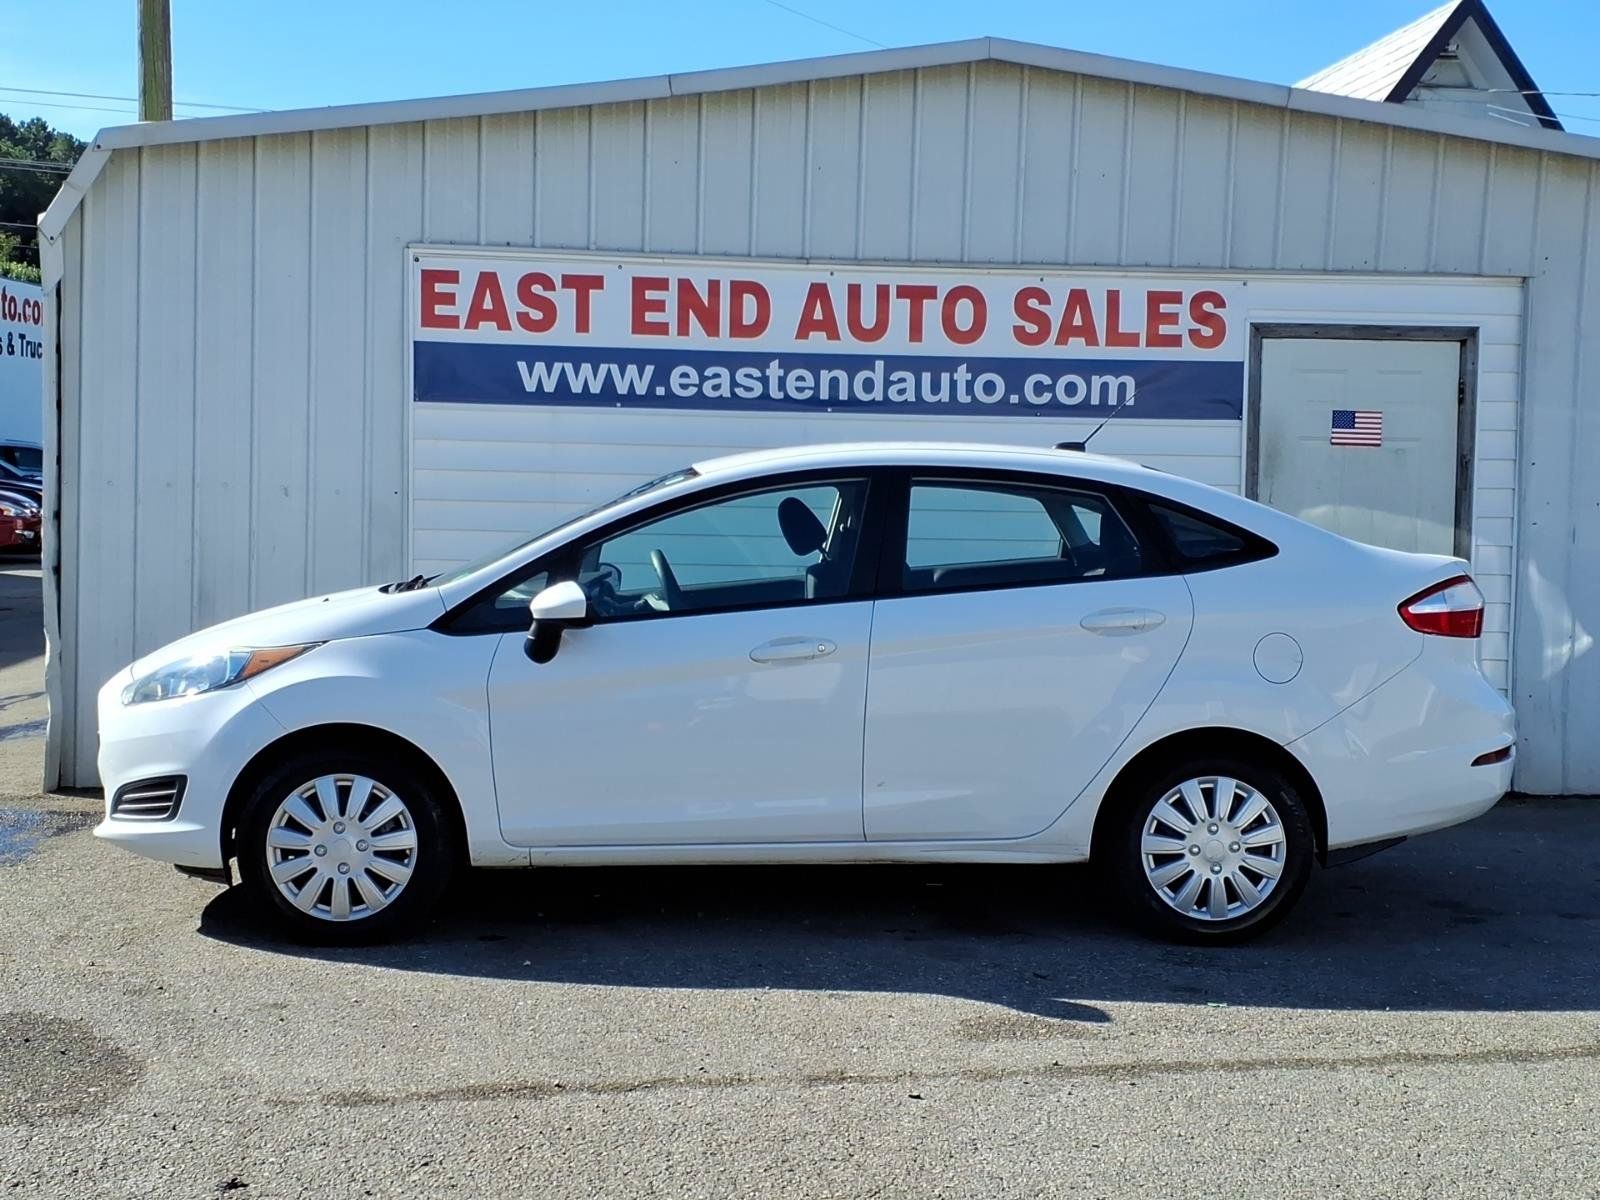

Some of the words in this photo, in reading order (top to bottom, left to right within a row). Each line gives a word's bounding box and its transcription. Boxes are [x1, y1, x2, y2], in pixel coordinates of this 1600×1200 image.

[1, 284, 43, 327] to.co
[420, 269, 604, 334] EAST
[631, 276, 771, 339] END
[794, 282, 988, 345] AUTO
[1012, 286, 1227, 349] SALES
[7, 331, 15, 356] &
[516, 359, 1136, 406] www.eastendauto.com
